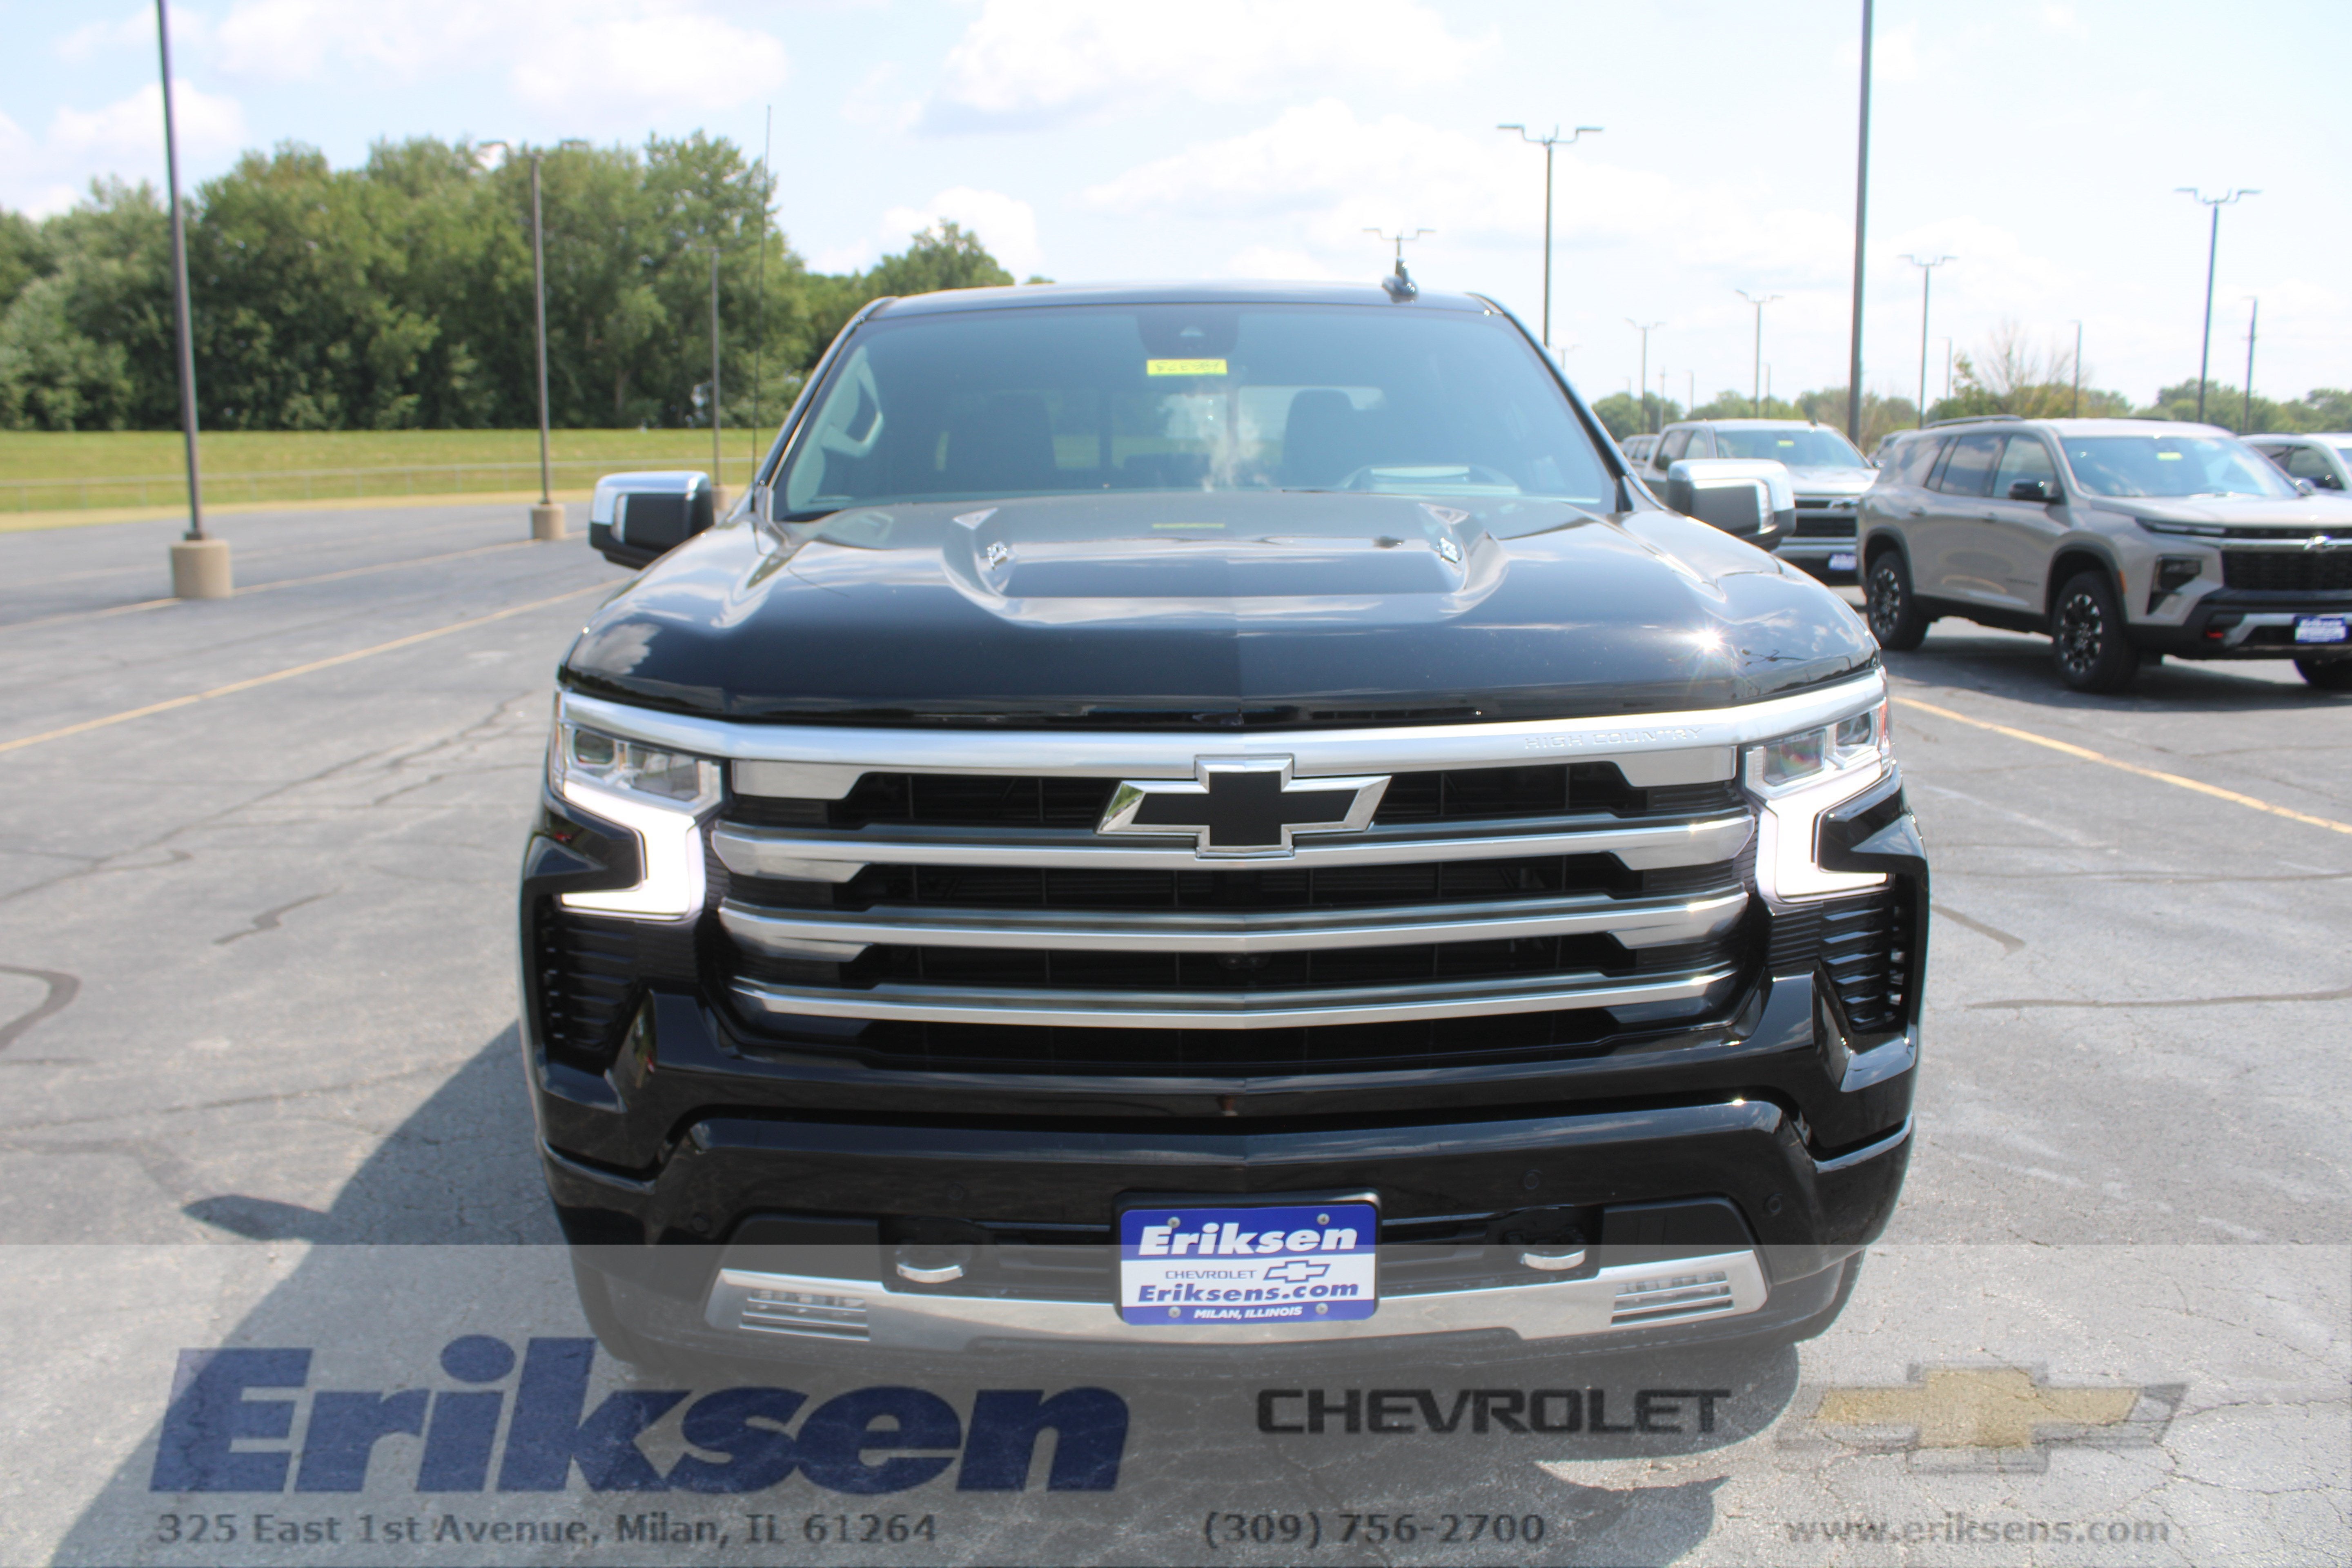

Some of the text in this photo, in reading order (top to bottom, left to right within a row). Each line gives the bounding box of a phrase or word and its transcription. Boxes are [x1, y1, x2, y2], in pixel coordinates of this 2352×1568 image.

[1524, 728, 1703, 749] HIGH COUNTRY
[1138, 1223, 1357, 1255] Eriksen
[1166, 1270, 1256, 1279] CHEVROLET
[1138, 1283, 1359, 1302] Eriksens.com
[1194, 1307, 1303, 1319] MILAN, ILLINOIS
